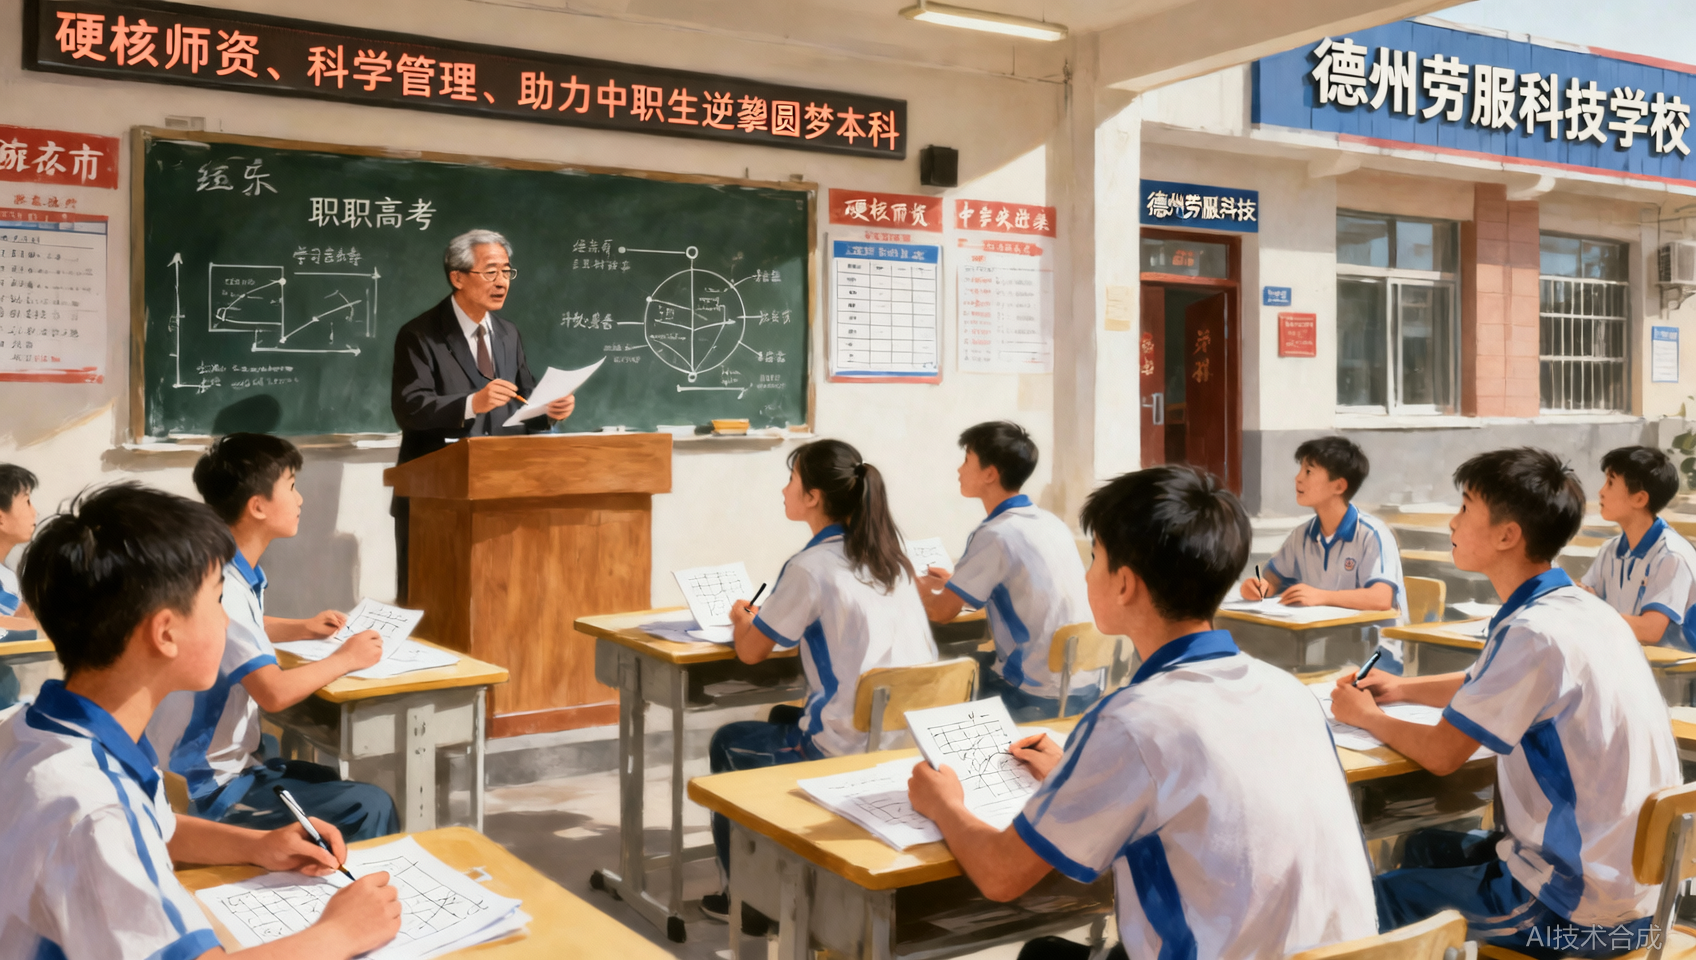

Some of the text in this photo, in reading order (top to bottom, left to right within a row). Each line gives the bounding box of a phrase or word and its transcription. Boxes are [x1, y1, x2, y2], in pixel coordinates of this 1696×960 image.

[1312, 36, 1692, 156] 德州劳服科技学校
[308, 196, 437, 231] 职职高考
[1146, 190, 1257, 222] 德州劳服科技
